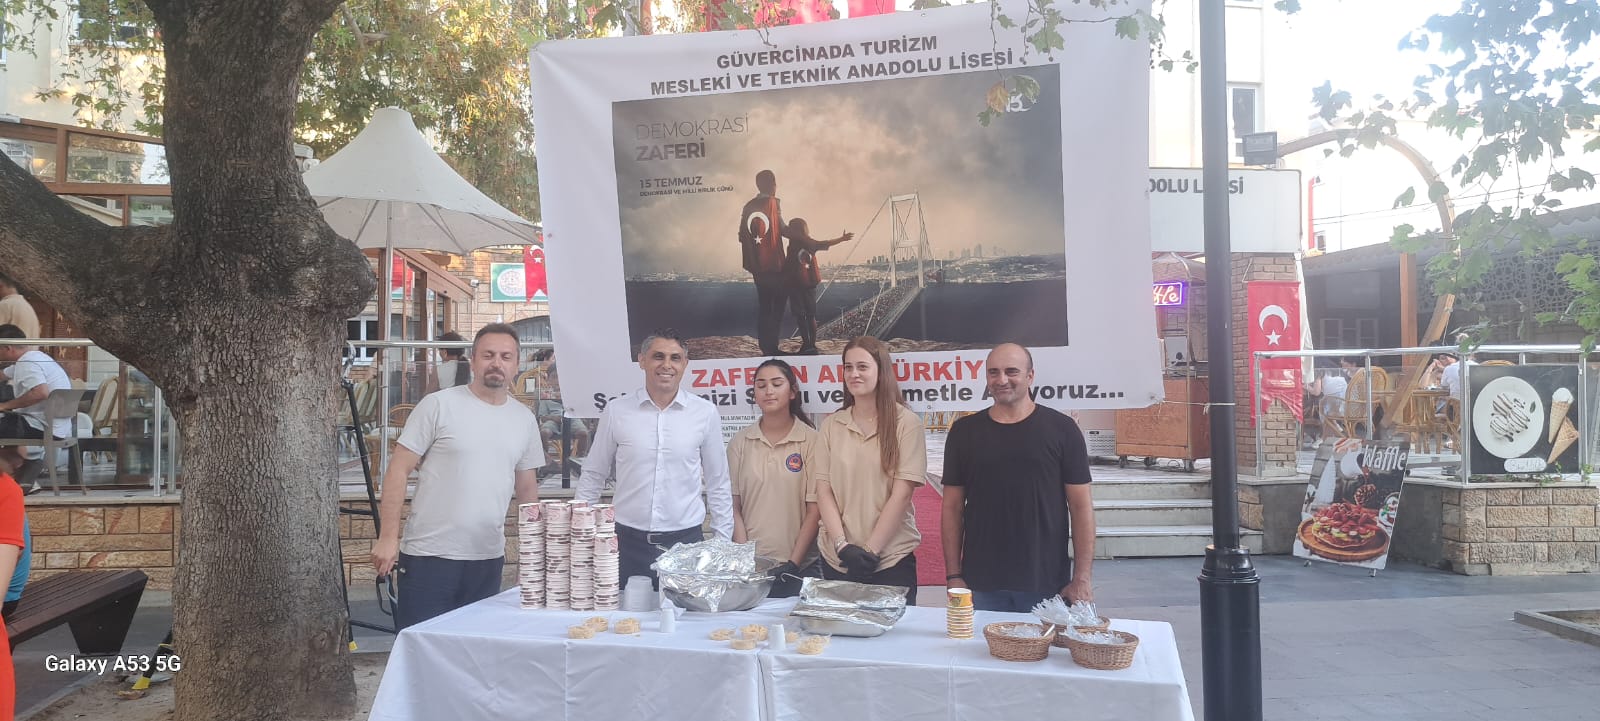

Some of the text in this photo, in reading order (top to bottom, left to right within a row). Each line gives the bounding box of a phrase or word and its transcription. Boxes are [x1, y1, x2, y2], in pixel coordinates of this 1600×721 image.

[717, 35, 937, 69] GÜVERCİNADA TURİZM
[651, 48, 1013, 95] MESLEKİ VE TEKNİK ANADOLU LİSESİ
[636, 112, 750, 140] DEMOKRASİ
[636, 138, 706, 161] ZAFERİ
[640, 176, 703, 189] 15 TEMMUZ
[1149, 176, 1244, 194] DOLU LSİ
[691, 365, 808, 388] ZAFEN
[891, 356, 984, 382] ÜRKİY
[817, 389, 844, 404] ve
[902, 384, 972, 402] metle
[1362, 444, 1407, 471] Waffle
